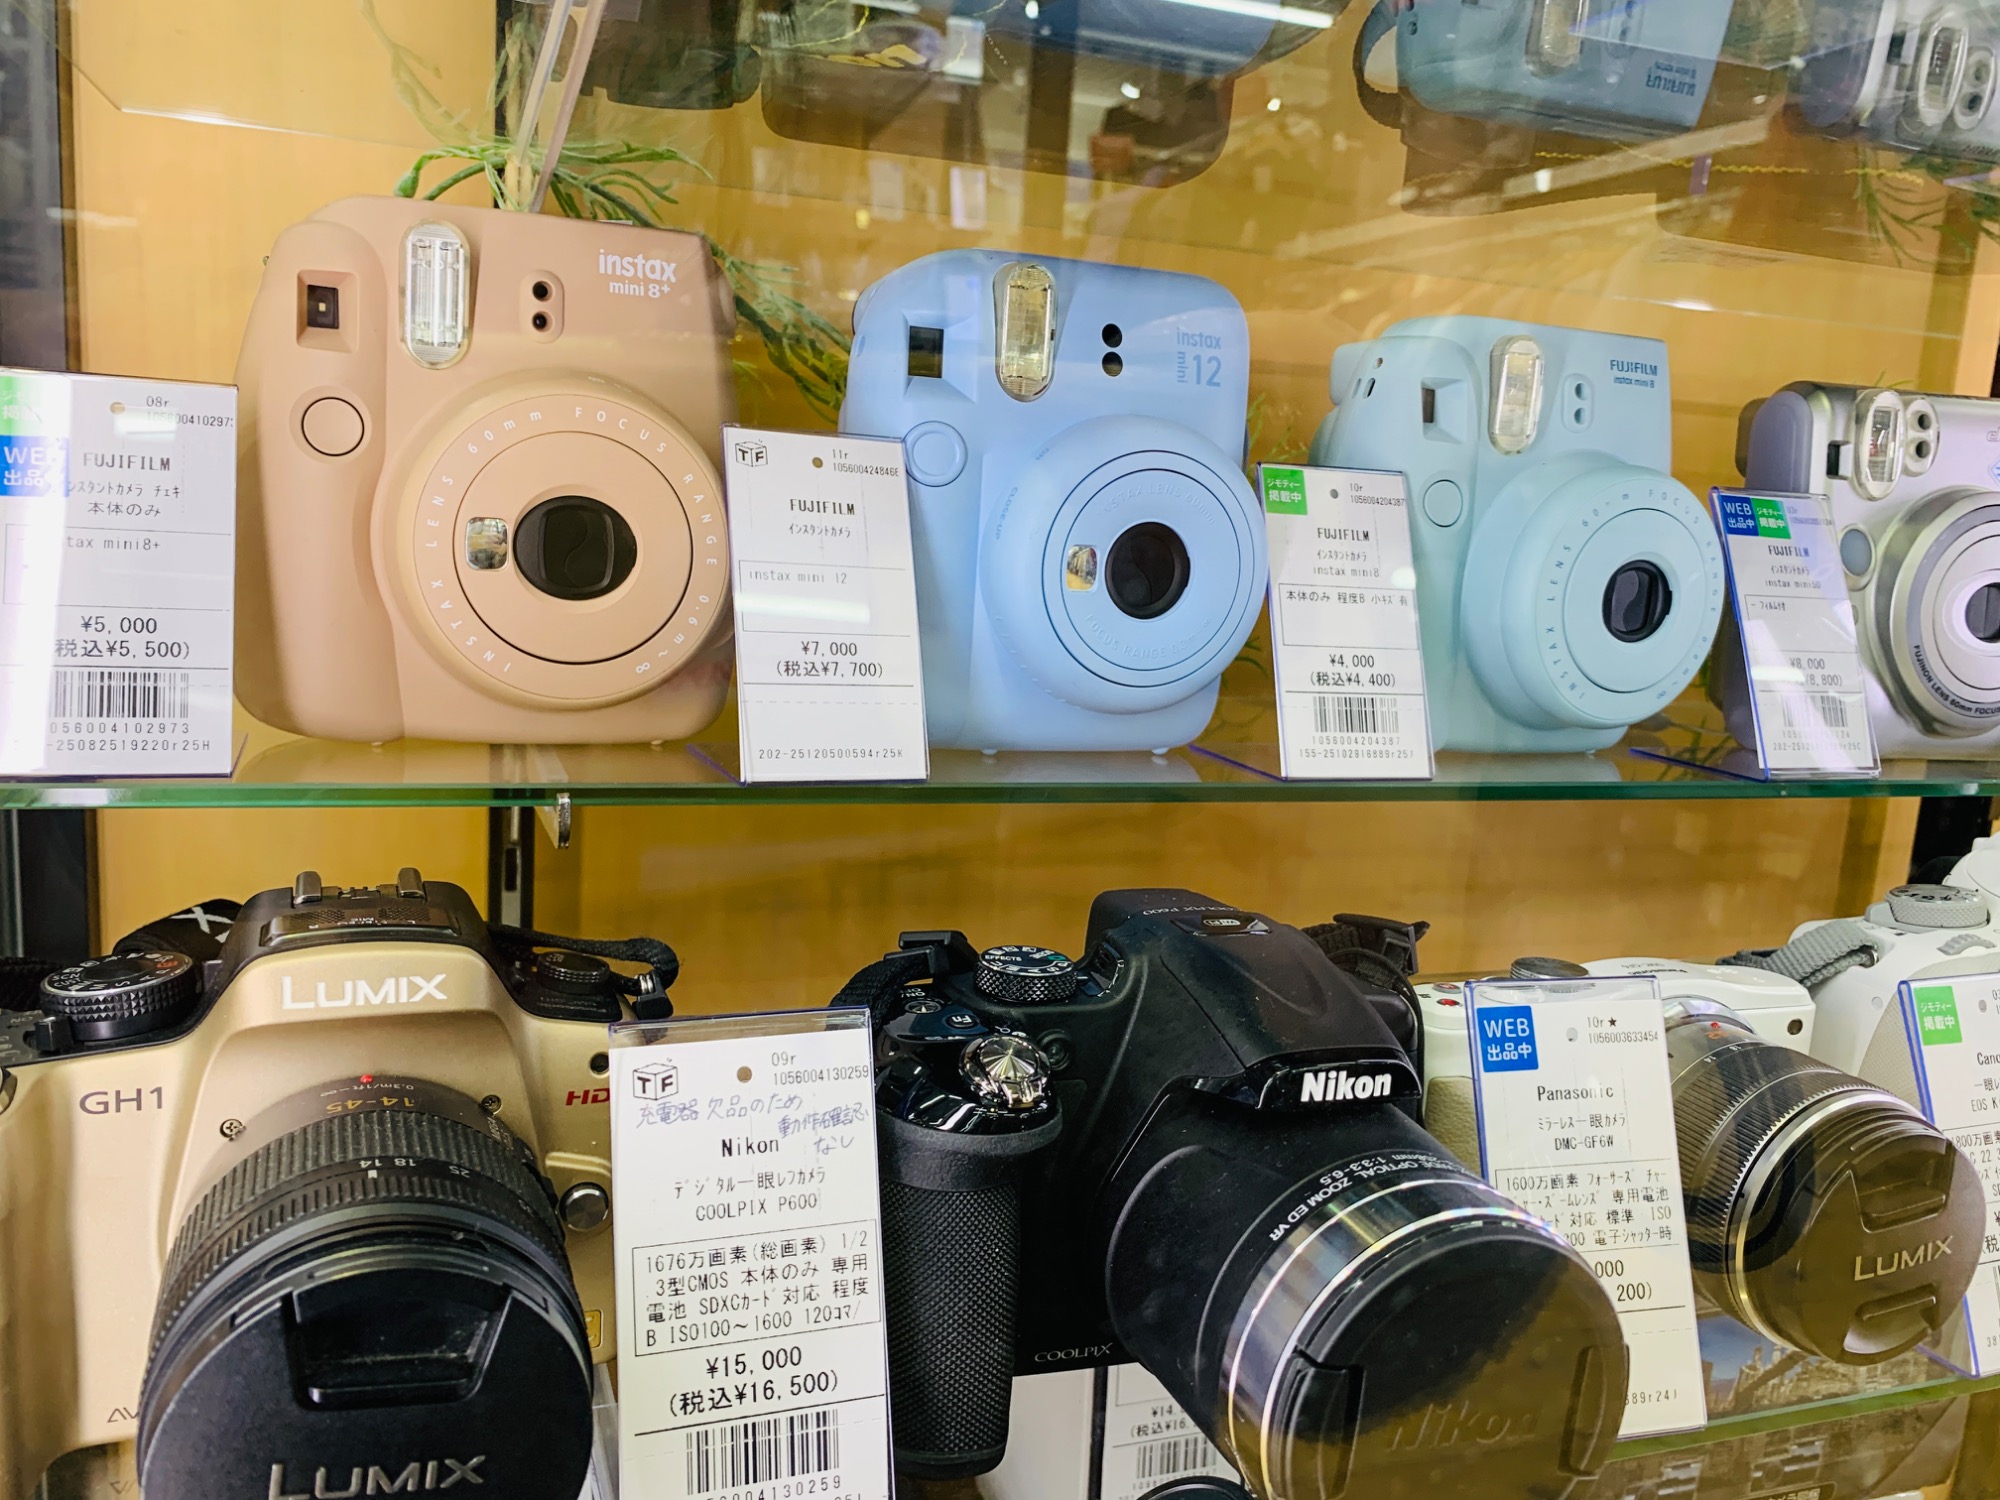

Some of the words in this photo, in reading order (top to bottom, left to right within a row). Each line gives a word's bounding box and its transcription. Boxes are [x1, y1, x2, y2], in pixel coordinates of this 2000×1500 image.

[599, 248, 677, 283] instax
[609, 280, 645, 296] mini
[647, 283, 671, 298] 8+
[1176, 326, 1221, 350] instax
[1177, 351, 1189, 383] mini
[1193, 354, 1222, 387] 12
[1609, 359, 1658, 377] FUJIFILM
[146, 396, 170, 408] 08r
[83, 452, 171, 471] FUJIFILM
[832, 449, 849, 460] 11r
[154, 485, 180, 499] チェキ
[425, 475, 454, 547] LENS
[575, 407, 666, 452] FOCUS
[682, 473, 717, 566] RANGE
[1267, 478, 1300, 488] ジモティー
[1349, 483, 1364, 493] 10r
[1268, 490, 1302, 503] 掲載中
[88, 502, 161, 517] 本体のみ
[790, 499, 855, 515] FUJIFILM
[1723, 502, 1752, 515] WEB
[788, 523, 851, 538] インスタントカメラ
[1727, 517, 1755, 529] 出品中
[1759, 517, 1785, 529] 掲載中
[1317, 527, 1370, 541] FUJIFILM
[103, 537, 161, 551] mini8+
[1768, 545, 1810, 557] FUJIFILM
[1317, 549, 1367, 563] インスタントカメラ
[750, 569, 791, 582] instax
[797, 571, 825, 582] mini
[835, 572, 848, 584] 12
[1313, 566, 1346, 576] instax
[1350, 567, 1380, 578] mini8
[1286, 590, 1331, 602] 本体のみ
[1337, 592, 1365, 604] 程度B
[81, 615, 158, 635] ¥5,000
[55, 638, 190, 659] 税込¥5,500)
[801, 641, 858, 658] ¥7,000
[776, 660, 883, 678] (税込¥7,700)
[1329, 654, 1375, 669] ¥4,000
[1790, 657, 1825, 671] ¥8,000
[1310, 672, 1396, 688] (税込¥4,400)
[1914, 644, 1934, 684] FUJINON
[1931, 682, 1950, 702] LENS
[50, 722, 190, 734] 056004102973
[984, 954, 1022, 962] EFFECTS
[281, 973, 447, 1010] LUMIX
[1920, 1002, 1952, 1013] ジモティー
[951, 1014, 972, 1024] Fn
[1483, 1017, 1530, 1038] WEB
[1587, 1017, 1604, 1028] 10r
[1923, 1015, 1955, 1031] 掲載中
[1588, 1031, 1659, 1044] 1056003633454
[771, 1052, 796, 1067] 09r
[1487, 1042, 1532, 1061] 出品中
[773, 1065, 869, 1086] 1056004130259
[1300, 1070, 1392, 1103] Nikon
[1537, 1085, 1614, 1101] Panasonic
[79, 1086, 163, 1115] GH1
[325, 1096, 414, 1115] 14-45
[1971, 1099, 1988, 1112] EOS
[1538, 1113, 1626, 1130] ミラーレス一眼カメラ
[722, 1136, 779, 1158] Nikon
[814, 1135, 855, 1156] なし
[1554, 1135, 1614, 1151] DMC-GF6W
[359, 1158, 382, 1169] 14
[394, 1157, 416, 1168] 18
[448, 1164, 471, 1179] 25
[1354, 1159, 1420, 1181] OPTICAL
[674, 1166, 826, 1199] デジタル一眼レフカメラ
[1306, 1176, 1353, 1206] ZOOM
[1507, 1173, 1579, 1191] 1600万画素
[1612, 1187, 1669, 1204] 専用電池
[695, 1198, 767, 1222] COOLPIX
[779, 1193, 818, 1213] P600
[1286, 1203, 1310, 1222] ED
[1606, 1209, 1635, 1224] 標準
[1650, 1206, 1671, 1221] ISO
[1268, 1223, 1291, 1242] VR
[1854, 1235, 1953, 1282] LUMIX
[741, 1261, 819, 1287] 本体のみ
[831, 1253, 868, 1275] 専用
[646, 1302, 687, 1324] 電池
[832, 1277, 870, 1299] 程度
[646, 1329, 656, 1347] B
[1034, 1342, 1113, 1363] COOLPIX
[705, 1346, 802, 1379] ¥15,000
[669, 1369, 839, 1417] (税込¥16,500)
[268, 1455, 487, 1500] LUMIX
